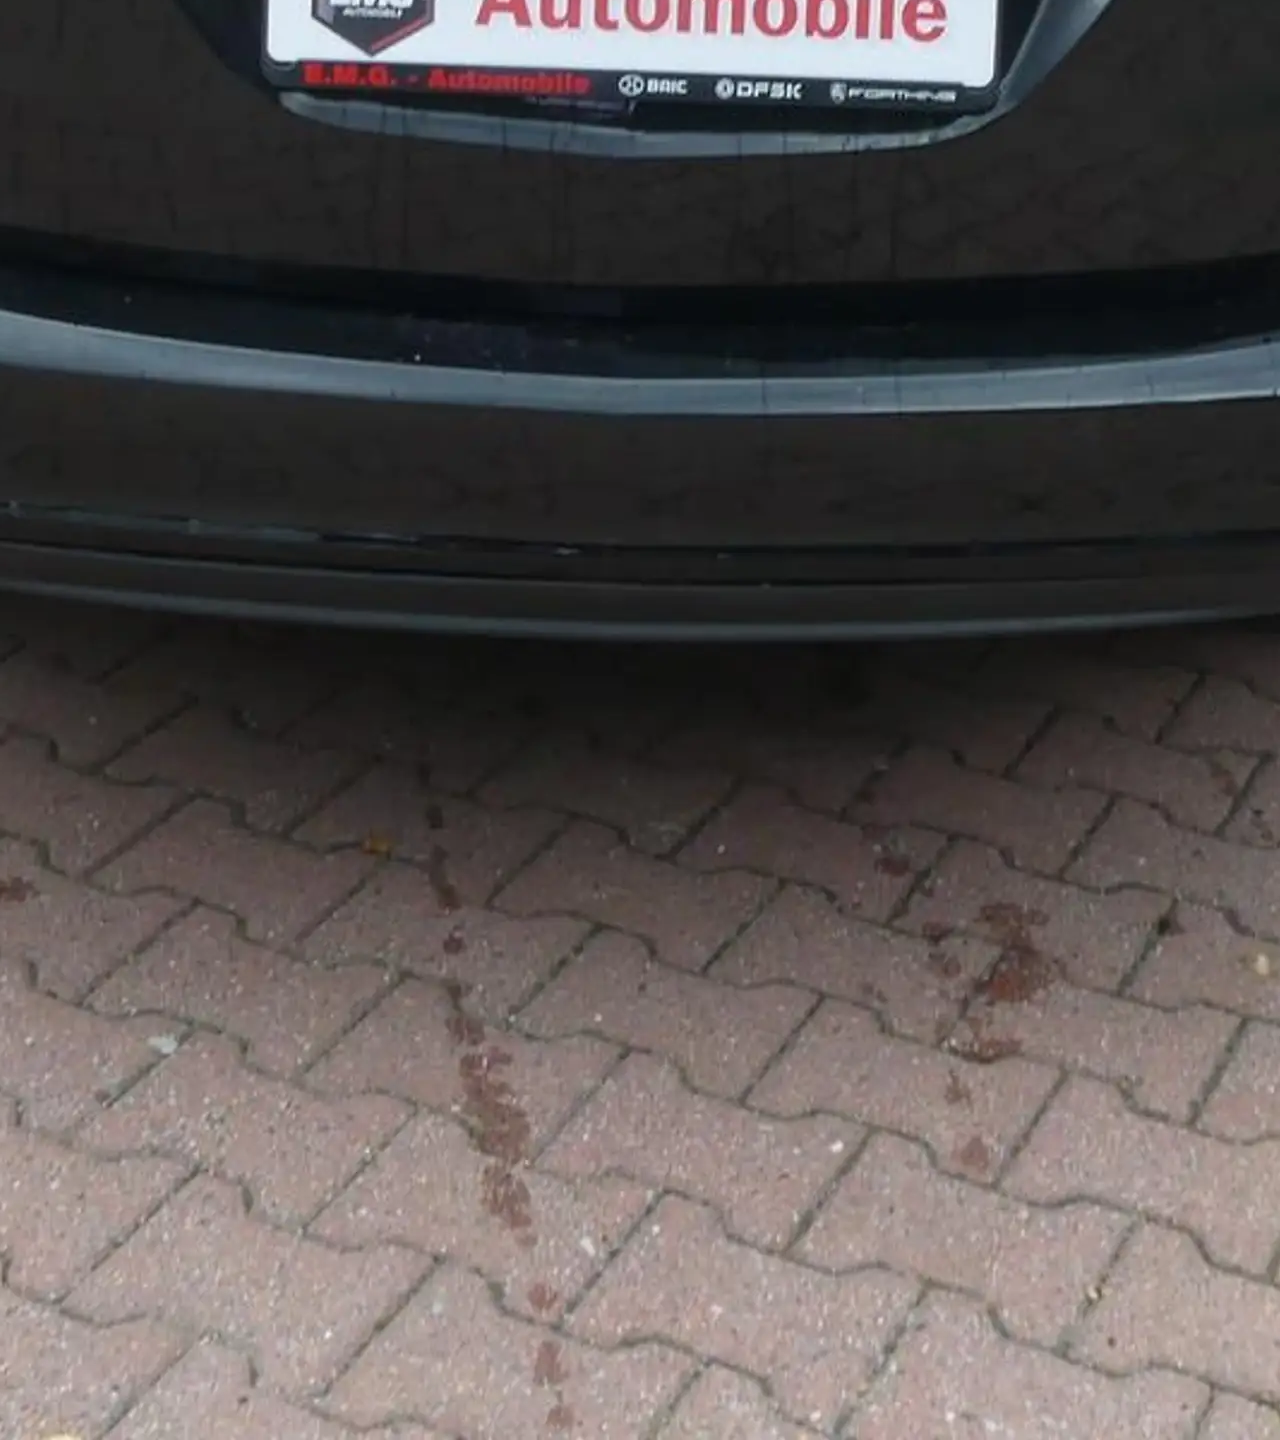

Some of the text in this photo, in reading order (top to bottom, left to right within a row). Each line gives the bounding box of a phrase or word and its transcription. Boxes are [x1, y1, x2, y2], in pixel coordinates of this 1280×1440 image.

[303, 62, 397, 85] E.M.G.
[428, 68, 591, 94] Automobile
[646, 78, 688, 95] BAIC
[736, 81, 803, 100] DFSK
